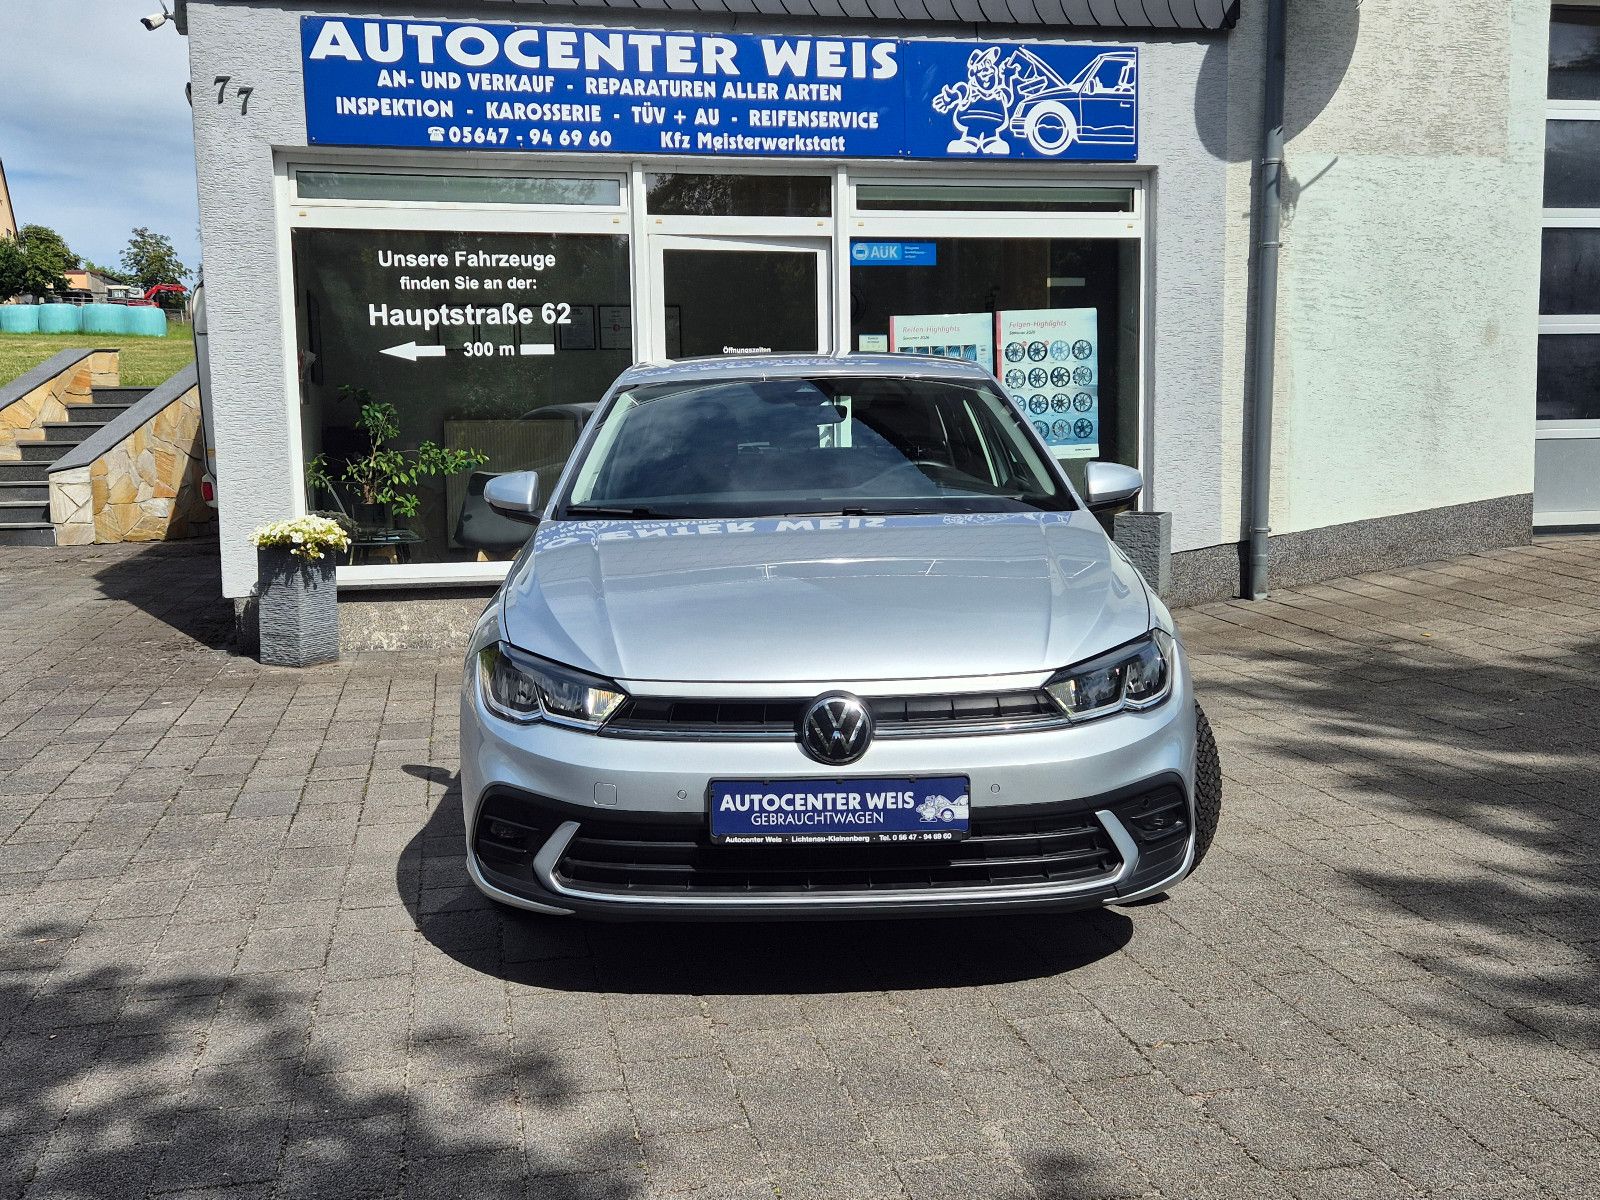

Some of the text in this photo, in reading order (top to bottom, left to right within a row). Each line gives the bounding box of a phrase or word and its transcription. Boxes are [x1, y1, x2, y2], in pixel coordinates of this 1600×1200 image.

[309, 21, 898, 79] AUTOCENTER WEIS
[378, 70, 414, 87] AN-
[421, 71, 461, 89] UND
[467, 73, 554, 93] VERKAUF
[586, 78, 716, 100] REPARATUREN
[723, 82, 779, 99] ALLER
[785, 84, 841, 101] ARTEN
[336, 97, 453, 117] INSPEKTION
[486, 102, 601, 122] KAROSSERIE
[632, 102, 665, 124] TÜV
[674, 110, 686, 124] +
[695, 108, 719, 125] AU
[749, 110, 879, 129] REIFENSERVICE
[449, 127, 508, 144] 05647
[530, 129, 552, 145] 94
[560, 130, 582, 145] 69
[589, 131, 611, 146] 60
[661, 132, 690, 149] Kfz
[698, 132, 845, 152] Meisterwerkstatt
[378, 250, 555, 270] Unsere Fahrzeuge
[400, 276, 536, 289] finden Sie an der:
[369, 303, 571, 330] Hauptstraße 62
[464, 342, 515, 357] 300 m
[720, 791, 915, 812] AUTOCENTER WEIS
[751, 811, 884, 826] GEBRAUCHTWAGEN
[791, 835, 870, 843] Lichtenau-Kleinenberg
